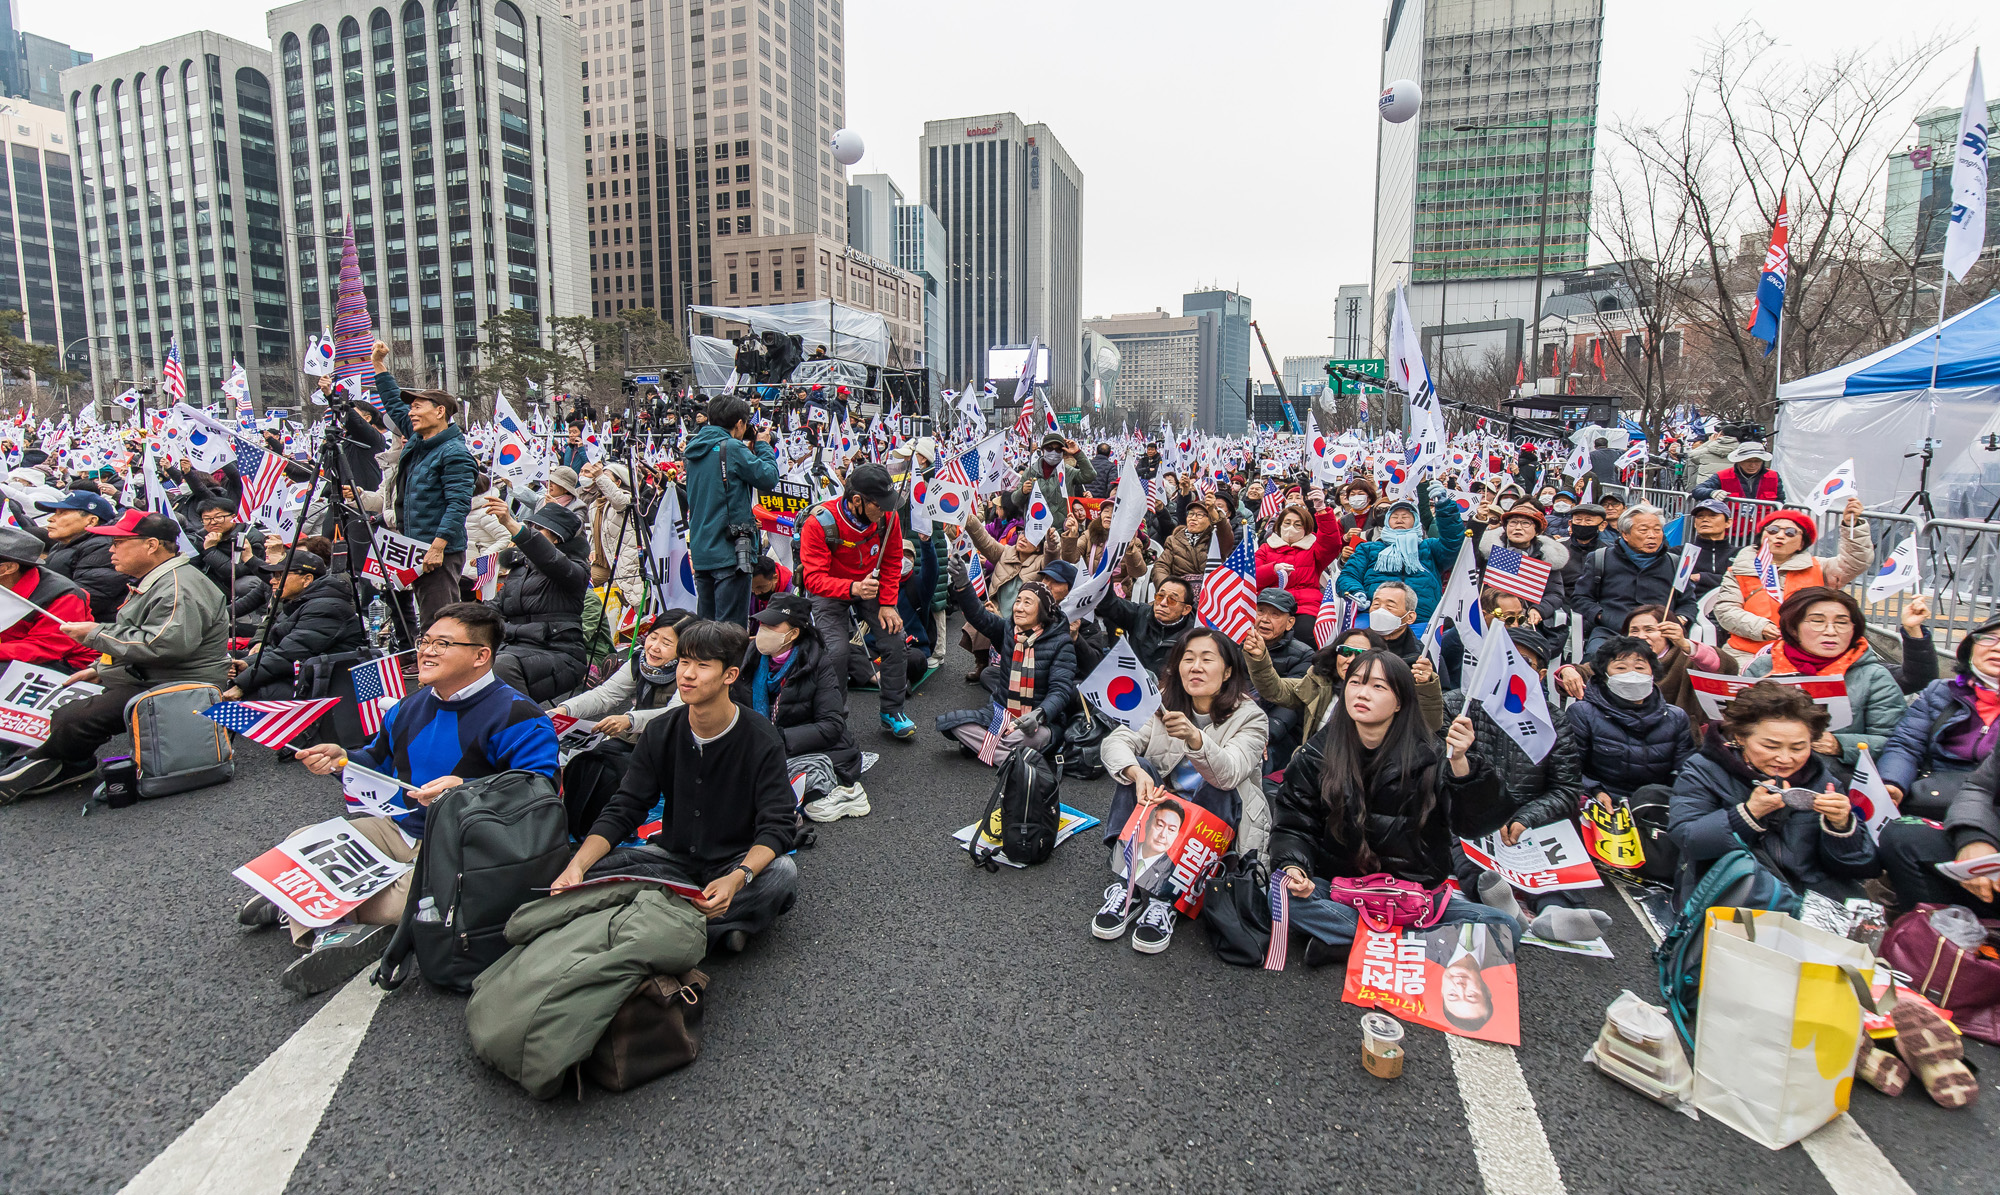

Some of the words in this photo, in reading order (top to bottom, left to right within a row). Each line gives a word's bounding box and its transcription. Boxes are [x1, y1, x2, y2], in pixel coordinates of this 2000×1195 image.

[966, 126, 997, 137] kobaco
[1030, 146, 1040, 190] 서울신문
[855, 251, 871, 266] SEOUL
[872, 258, 892, 274] FINANCE
[891, 266, 906, 278] CENTER
[1766, 275, 1783, 290] SINCE
[760, 495, 785, 513] 탄핵
[783, 482, 809, 499] 대통령
[271, 866, 341, 918] 주사파
[1365, 928, 1428, 964] 무효
[1360, 958, 1427, 996] 원천
